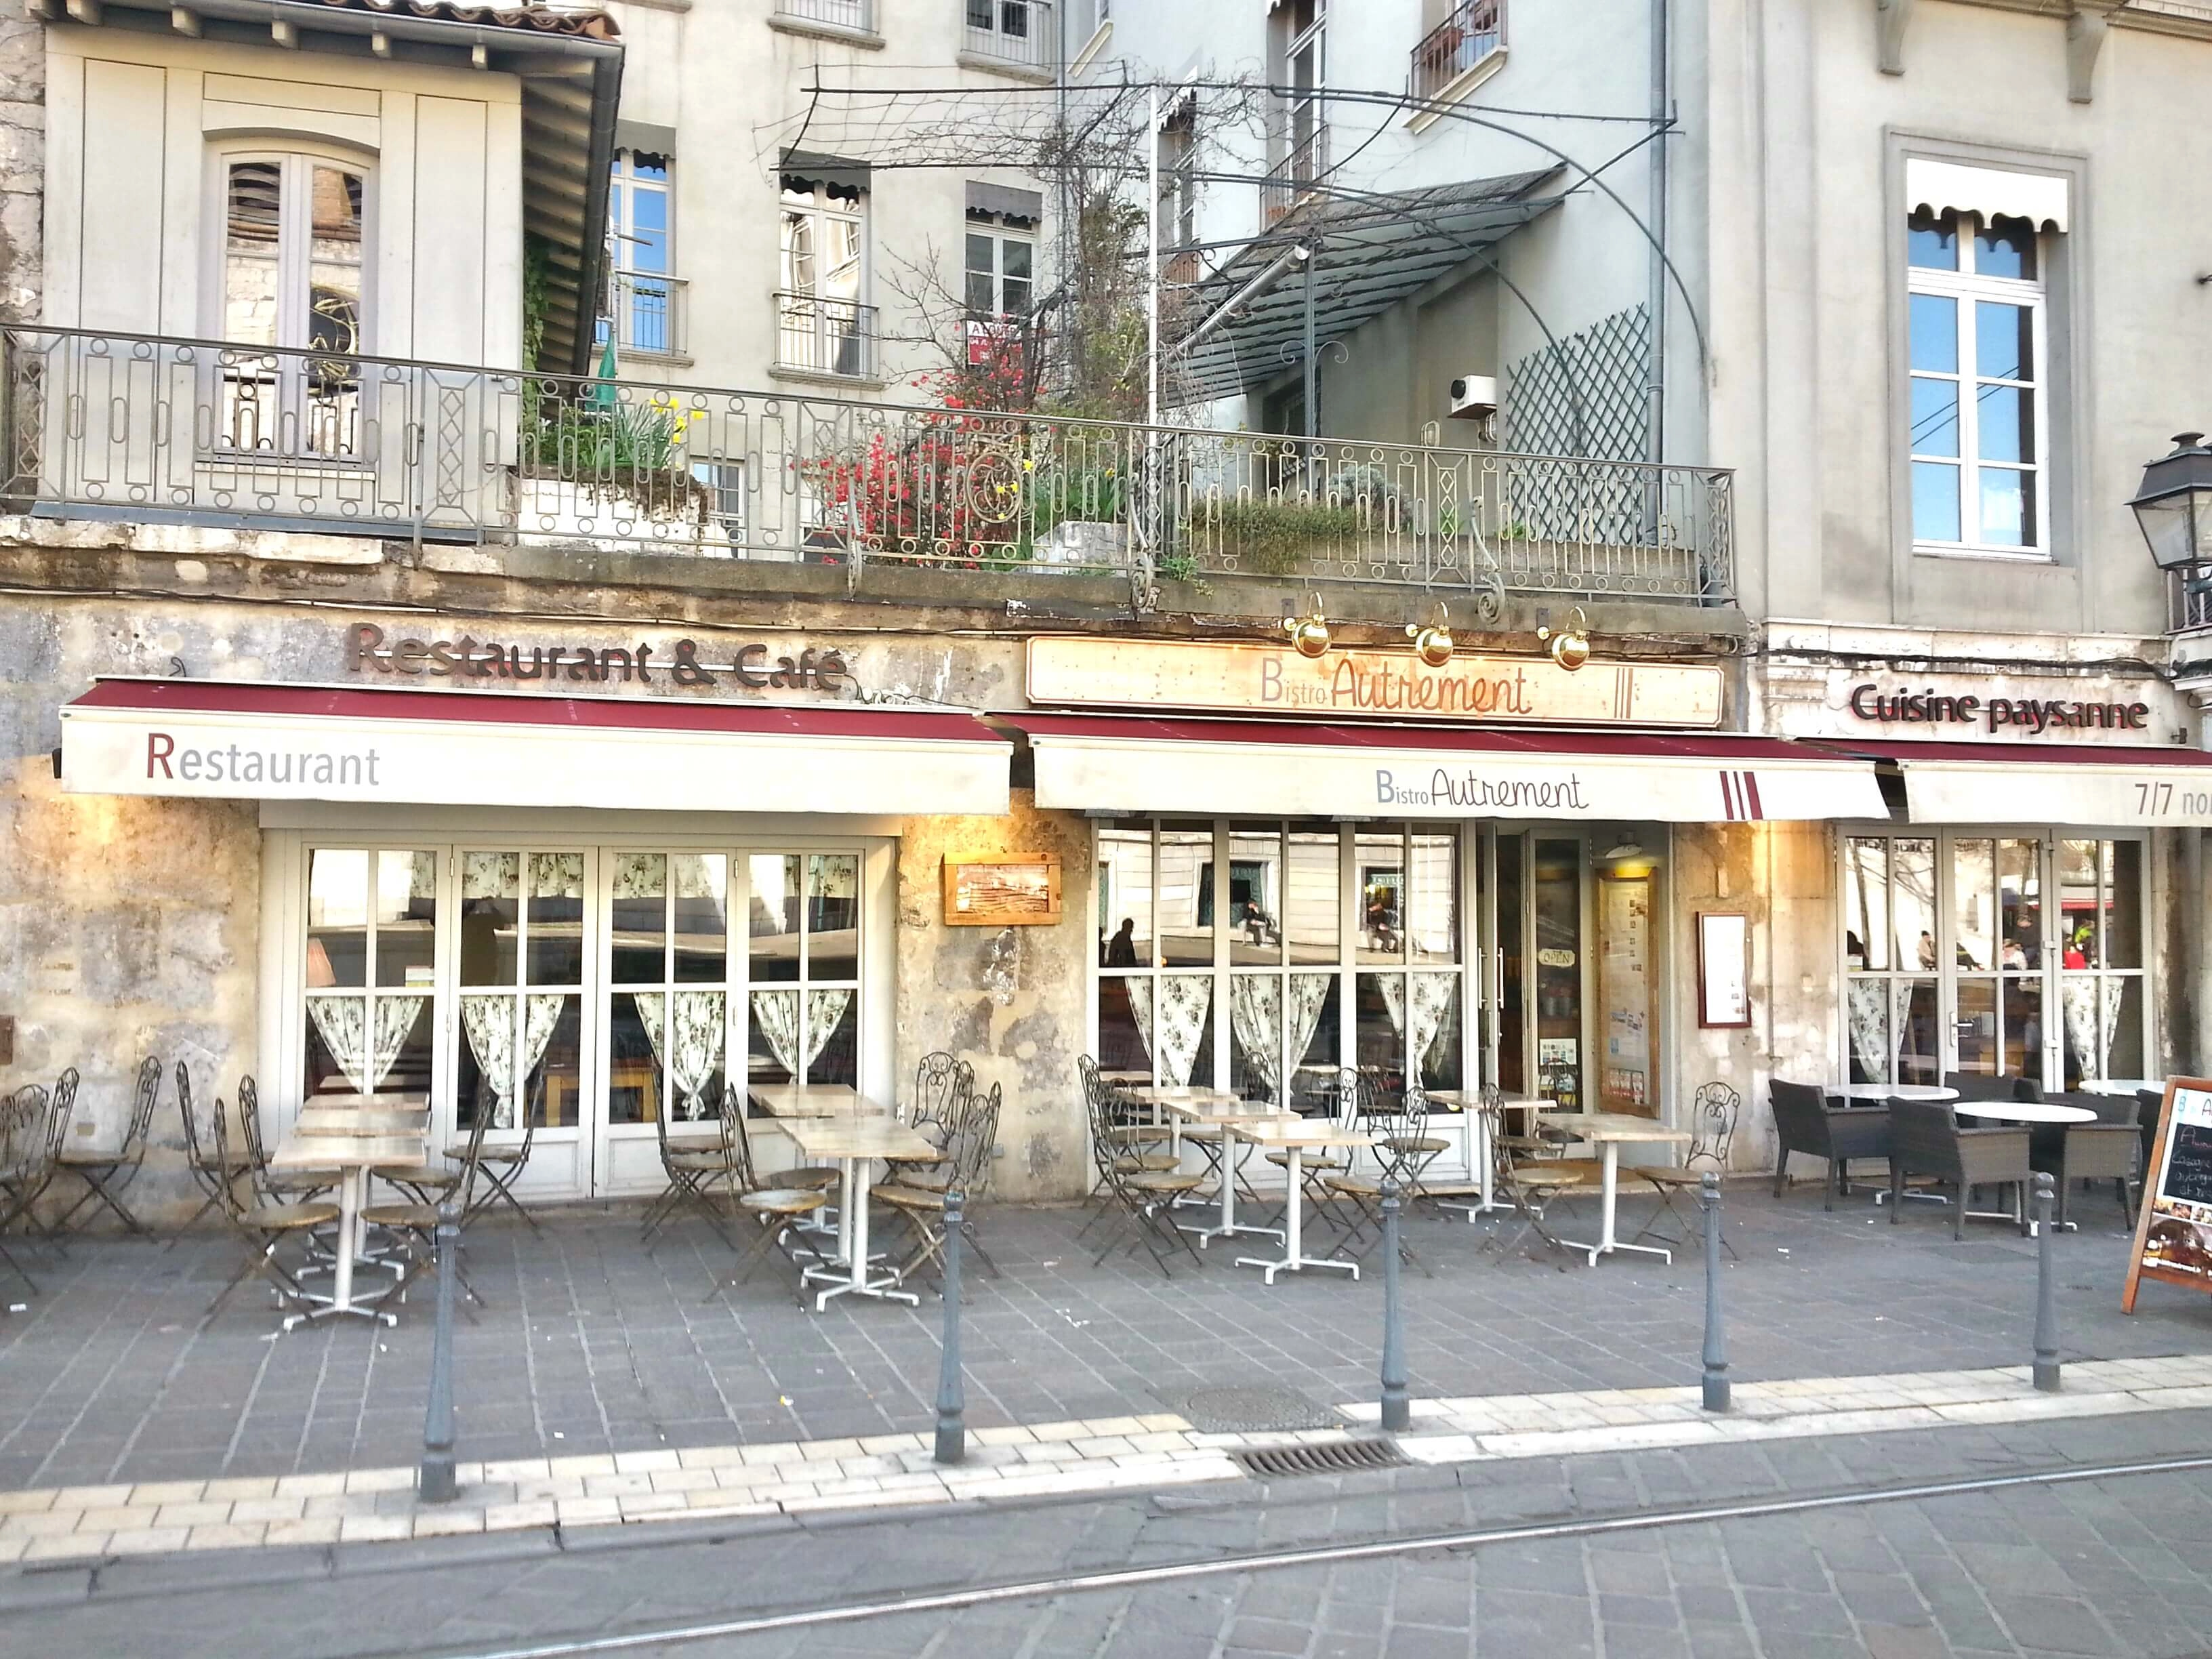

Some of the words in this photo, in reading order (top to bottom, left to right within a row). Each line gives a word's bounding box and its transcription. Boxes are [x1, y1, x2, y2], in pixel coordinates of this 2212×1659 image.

[349, 621, 653, 683] Restaurant
[672, 638, 717, 686] &
[733, 643, 847, 691] Café
[1261, 657, 1326, 705] Bistro
[1331, 658, 1533, 715] Autrement
[1851, 684, 1980, 722] Cuisine
[1990, 696, 2149, 735] paysanne
[146, 732, 380, 786] Restaurant
[1376, 769, 1429, 805] Bistro
[1431, 769, 1589, 810] Autrement
[2135, 781, 2173, 817] 7/7
[2183, 793, 2212, 815] no
[1544, 952, 1570, 964] OPEN
